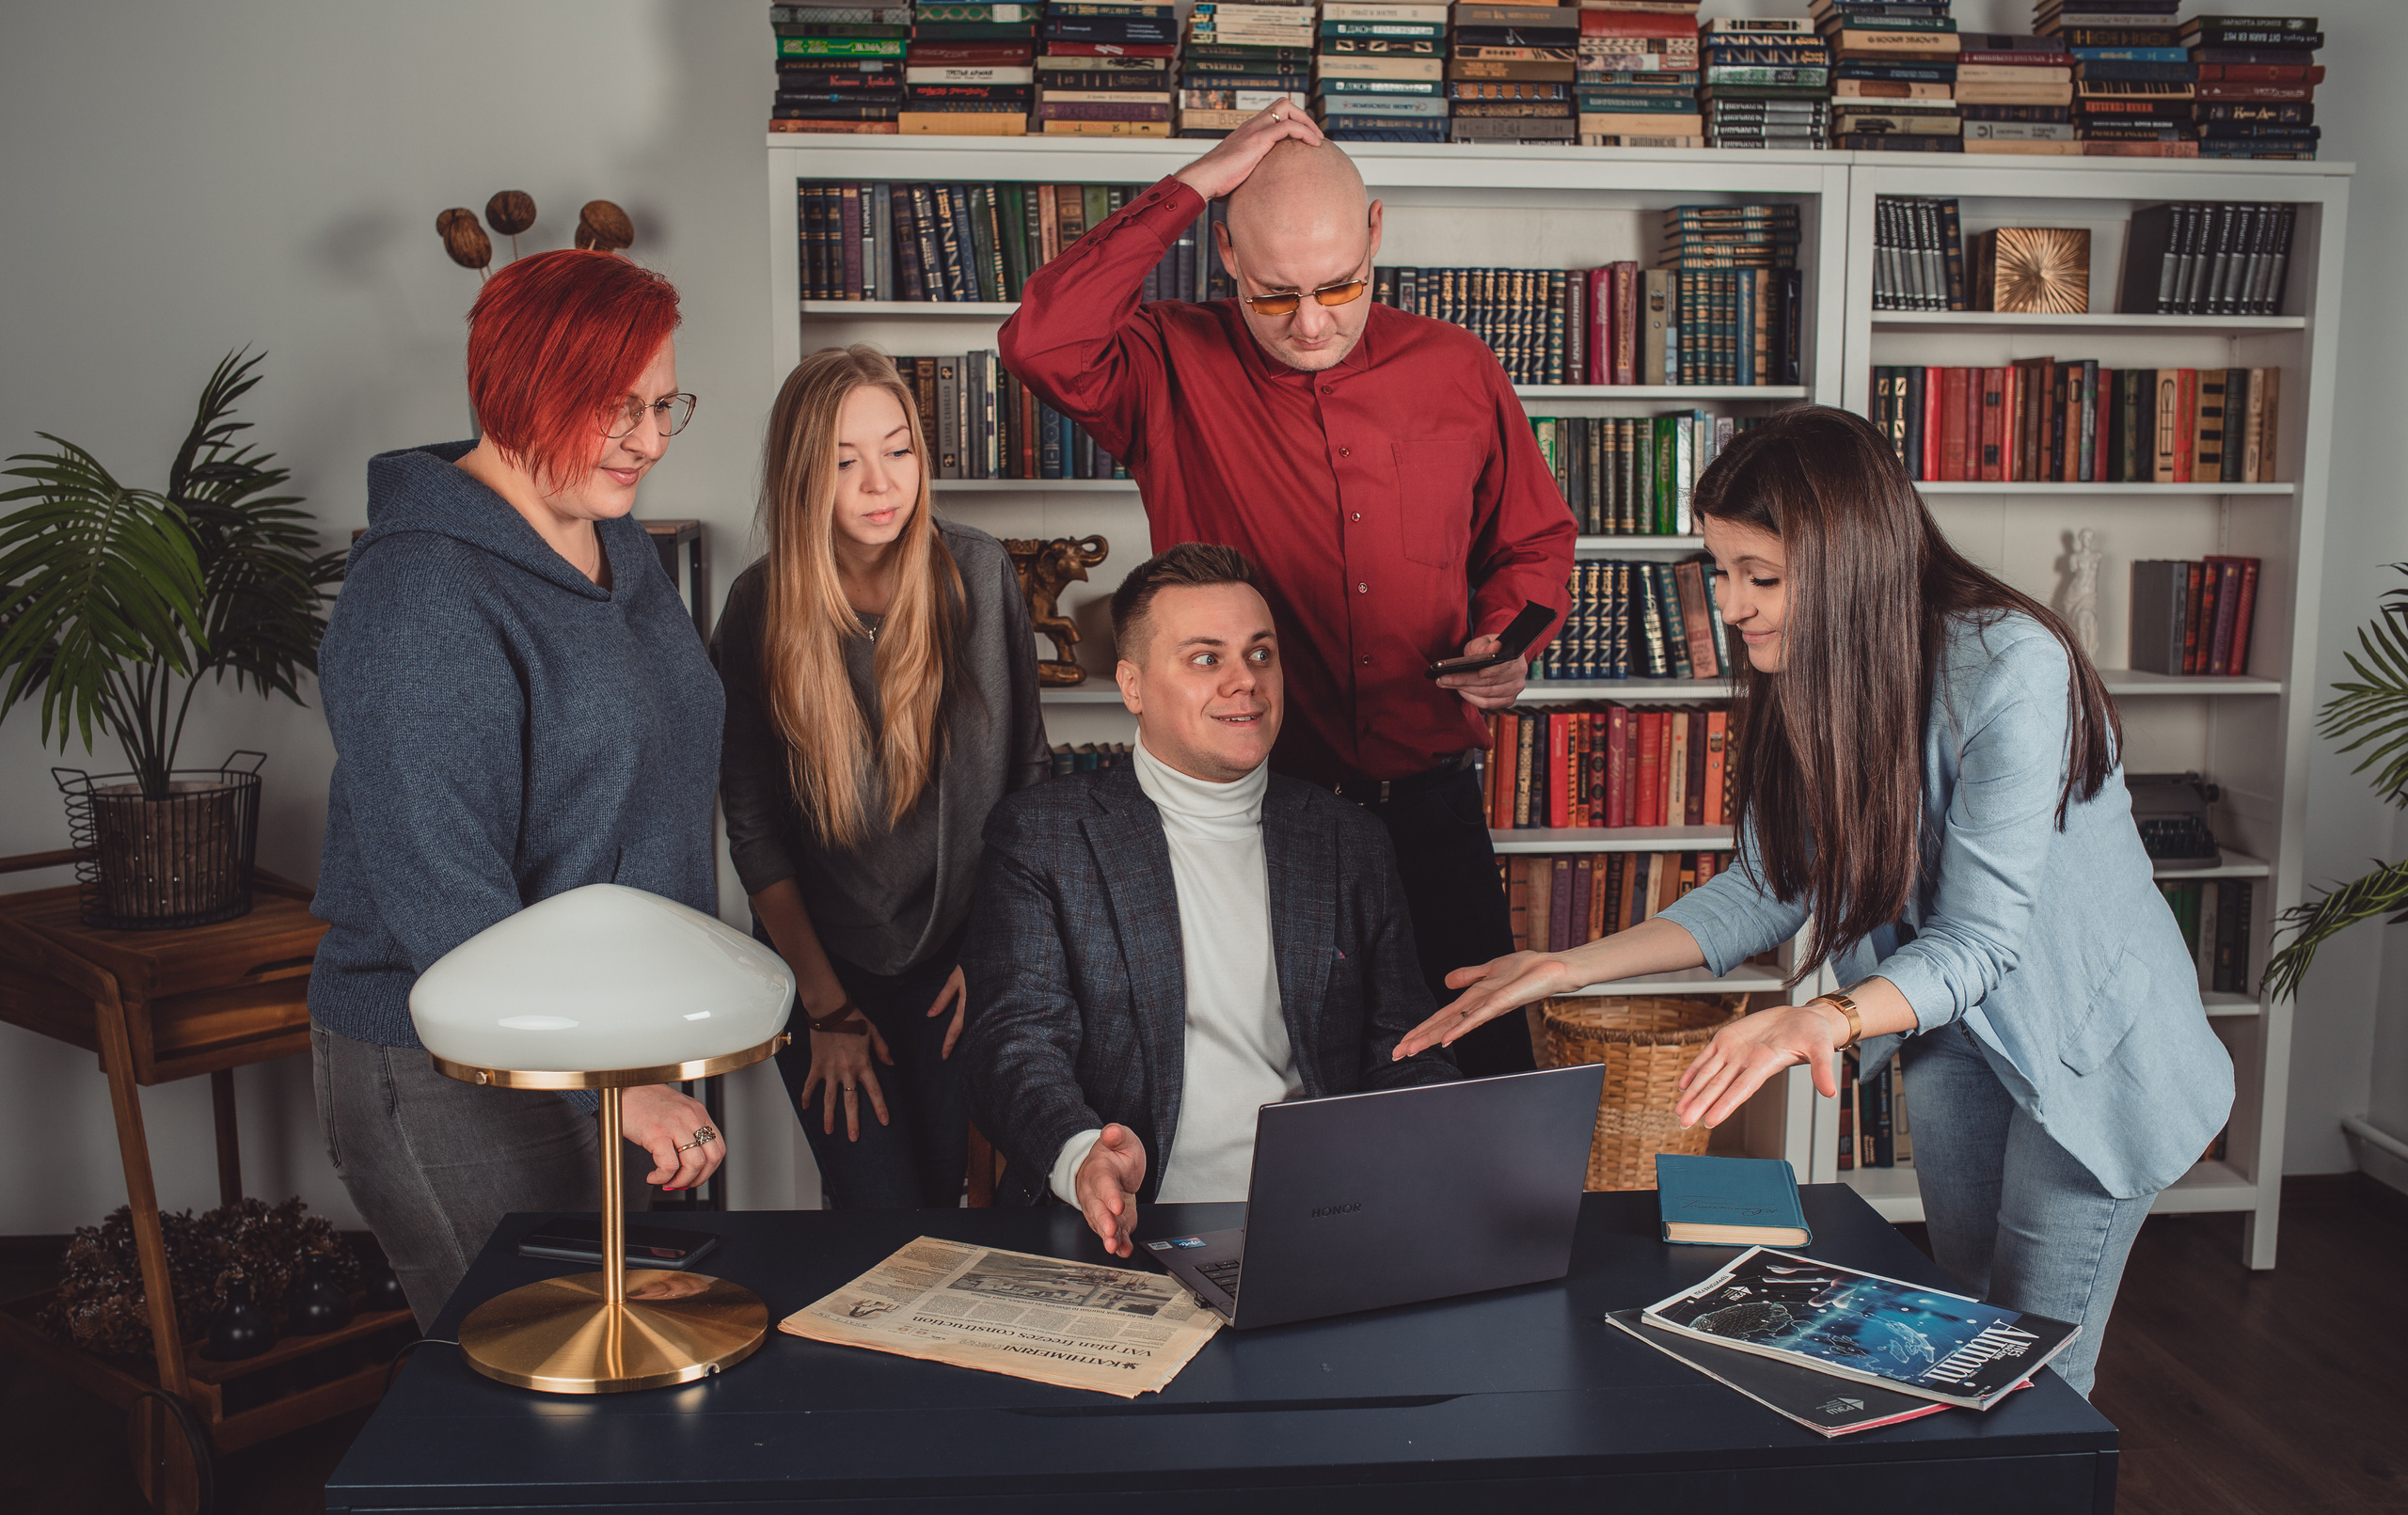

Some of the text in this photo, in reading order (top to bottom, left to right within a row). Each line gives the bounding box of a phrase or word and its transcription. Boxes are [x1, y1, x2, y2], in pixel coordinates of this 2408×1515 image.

[1661, 434, 1671, 482] СПАРТАК
[1310, 1203, 1362, 1220] HONOR
[1043, 1302, 1071, 1312] diversify
[1079, 1306, 1105, 1315] tourism
[835, 1317, 868, 1328] WHAT'S
[911, 1316, 1016, 1337] construction
[1018, 1333, 1078, 1349] freezes
[1078, 1340, 1117, 1354] plan
[1002, 1344, 1123, 1368] KATHIMERINI
[1117, 1346, 1153, 1358] VAT
[1922, 1318, 2040, 1384] Alumni
[1825, 1404, 1855, 1415] РЭШ
